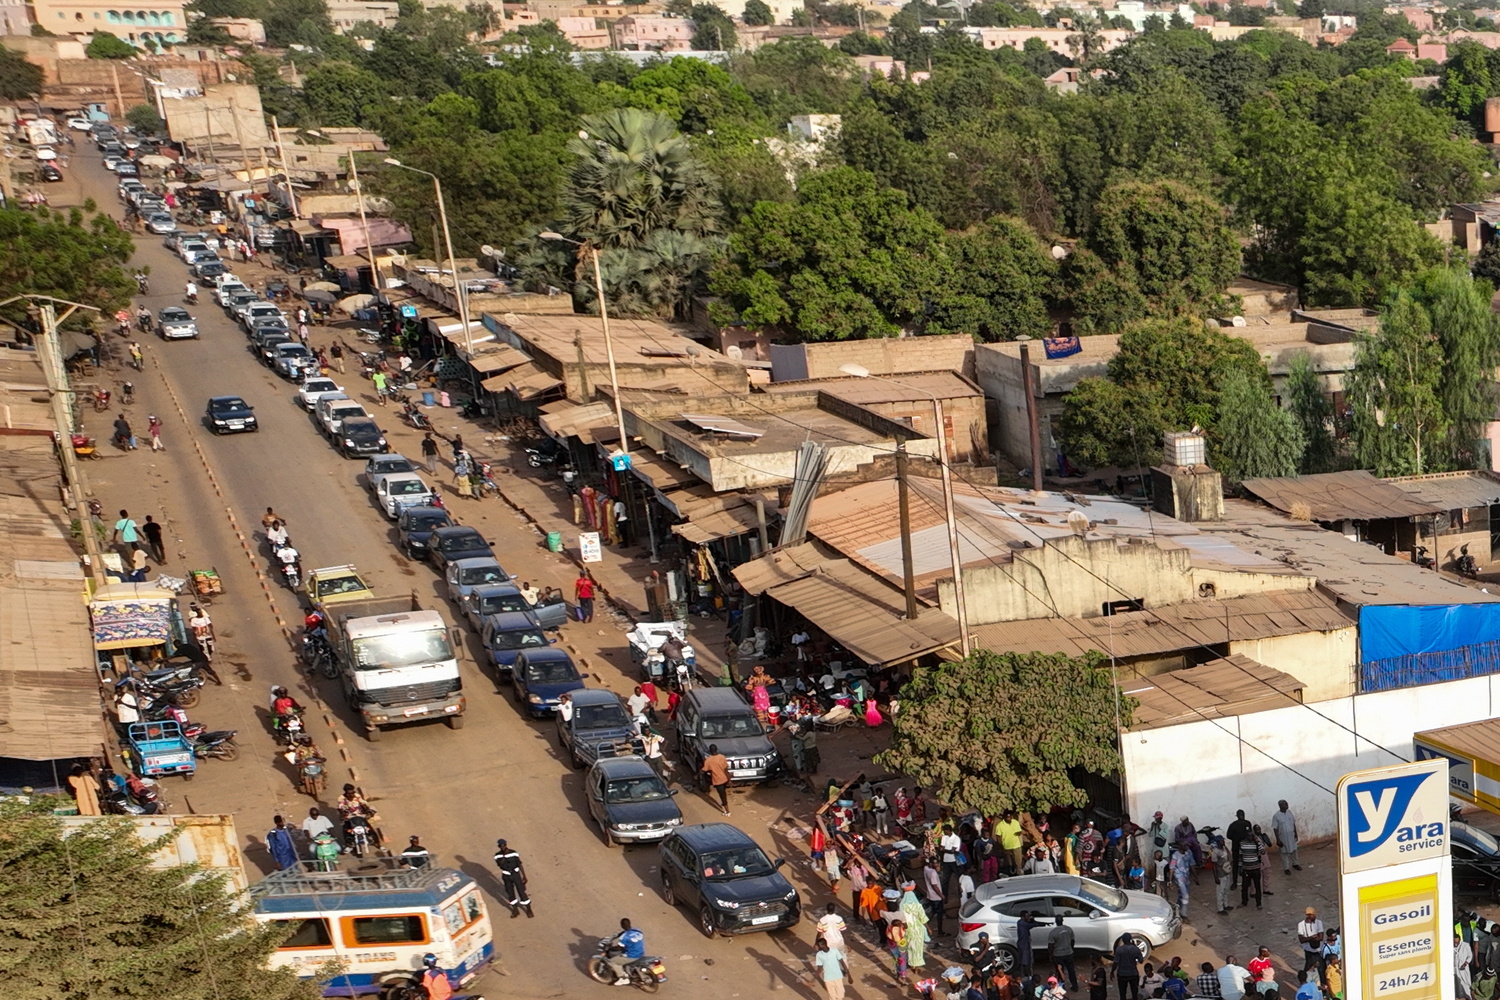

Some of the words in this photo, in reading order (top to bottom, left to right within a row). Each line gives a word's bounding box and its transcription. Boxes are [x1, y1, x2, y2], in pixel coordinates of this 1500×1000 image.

[1398, 838, 1443, 853] service
[1374, 904, 1431, 925] Gasoil
[1378, 937, 1431, 954] Essence
[1379, 952, 1397, 960] Super
[1379, 971, 1430, 991] 24h/24
